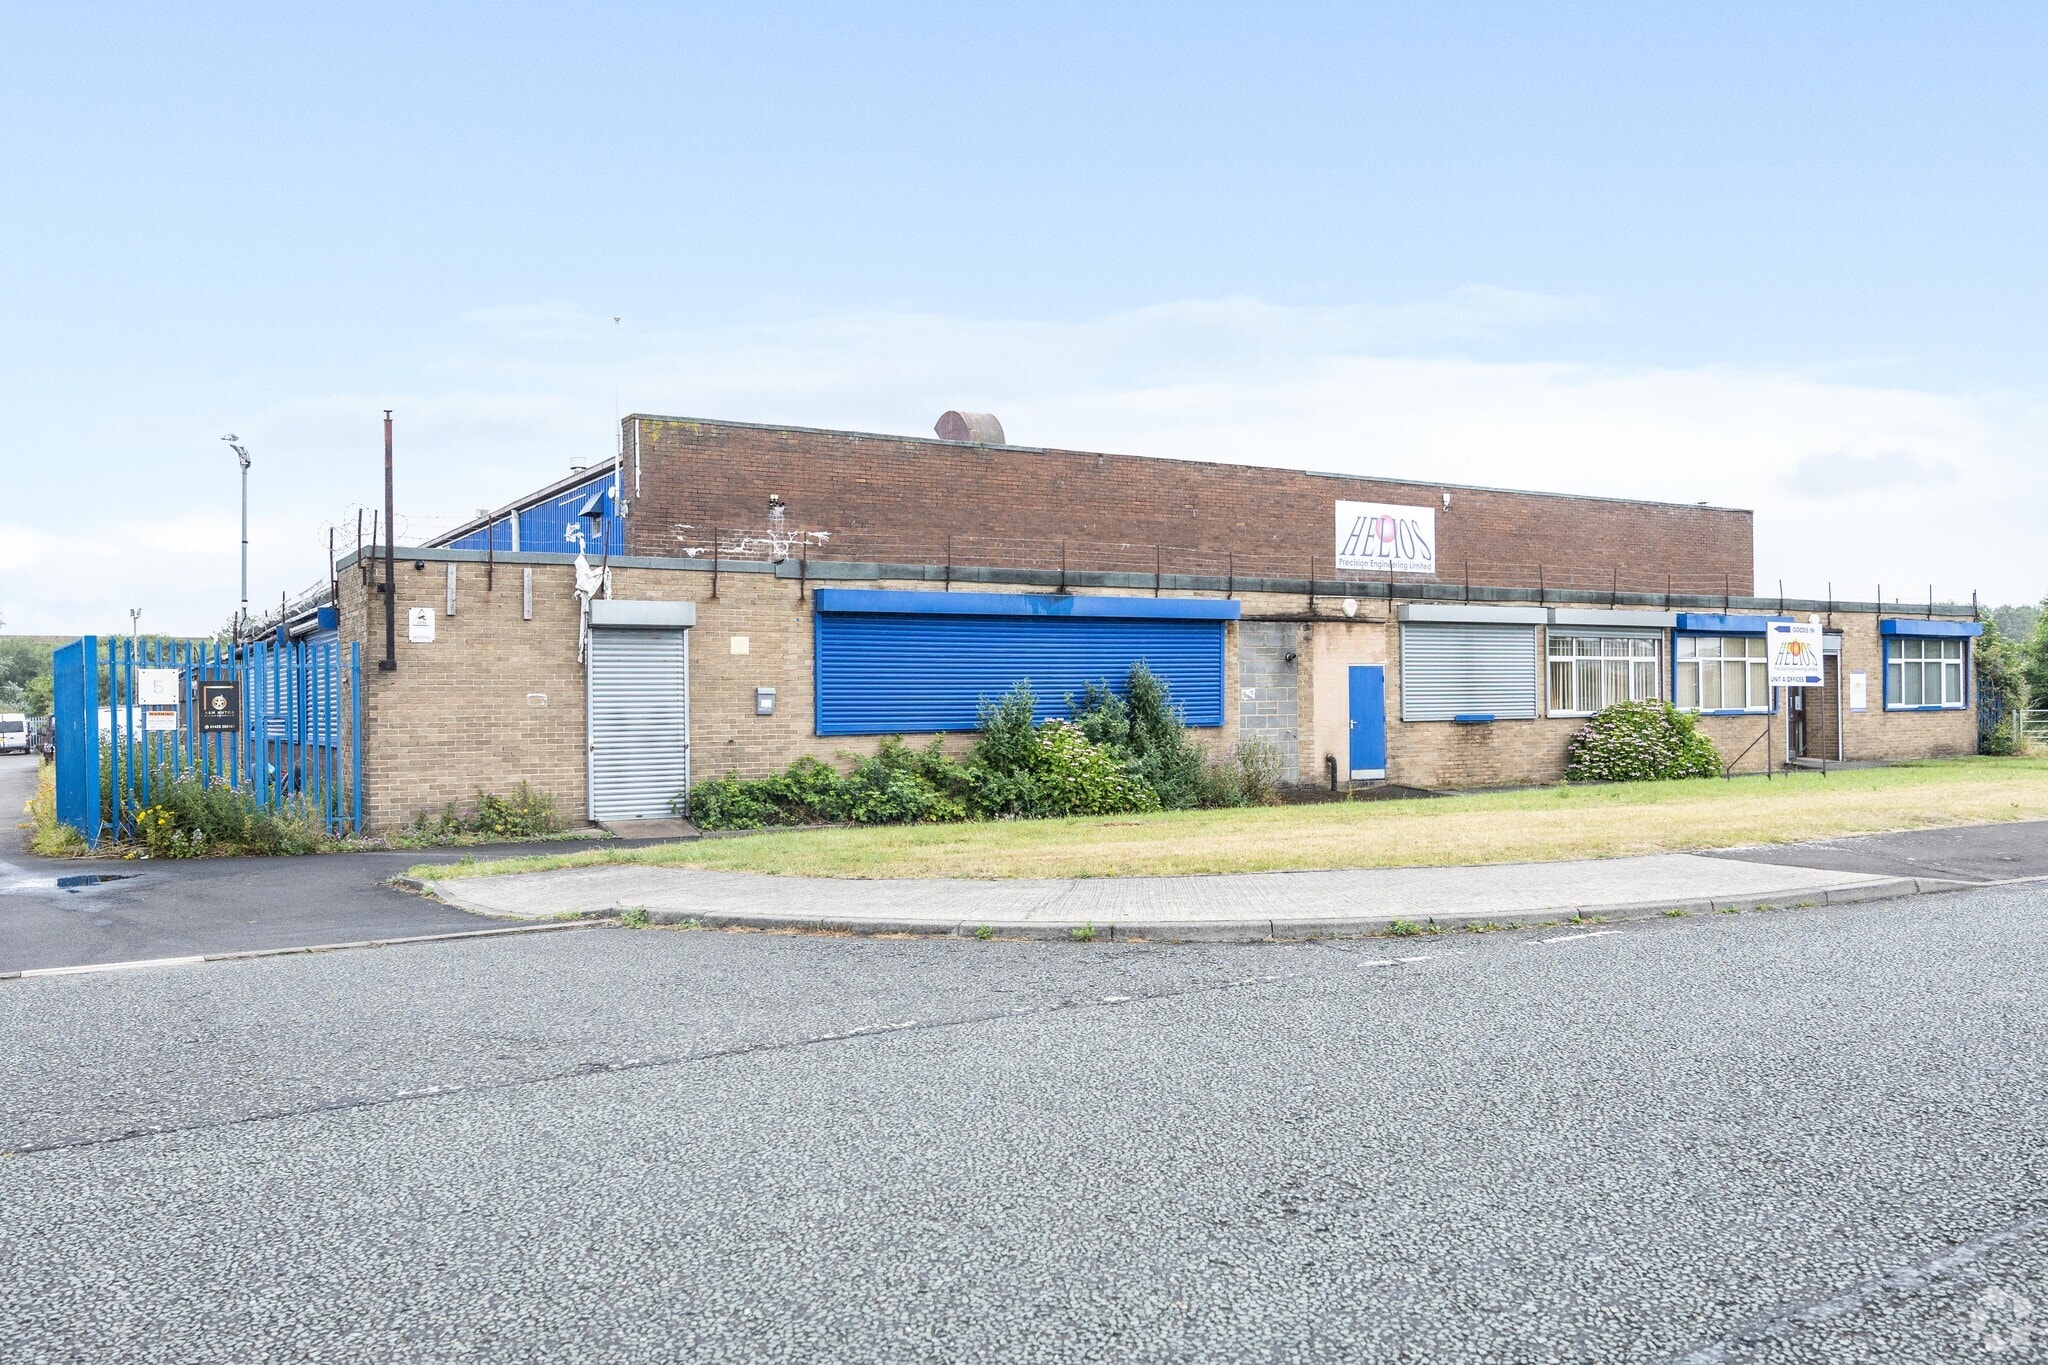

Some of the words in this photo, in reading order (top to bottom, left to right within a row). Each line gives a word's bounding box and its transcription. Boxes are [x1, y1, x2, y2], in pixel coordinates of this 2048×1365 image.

[1339, 516, 1432, 561] HELIOS
[1339, 559, 1369, 567] Precision
[1410, 562, 1432, 570] Limited
[1775, 642, 1818, 666] HELIOS
[153, 680, 164, 694] 5
